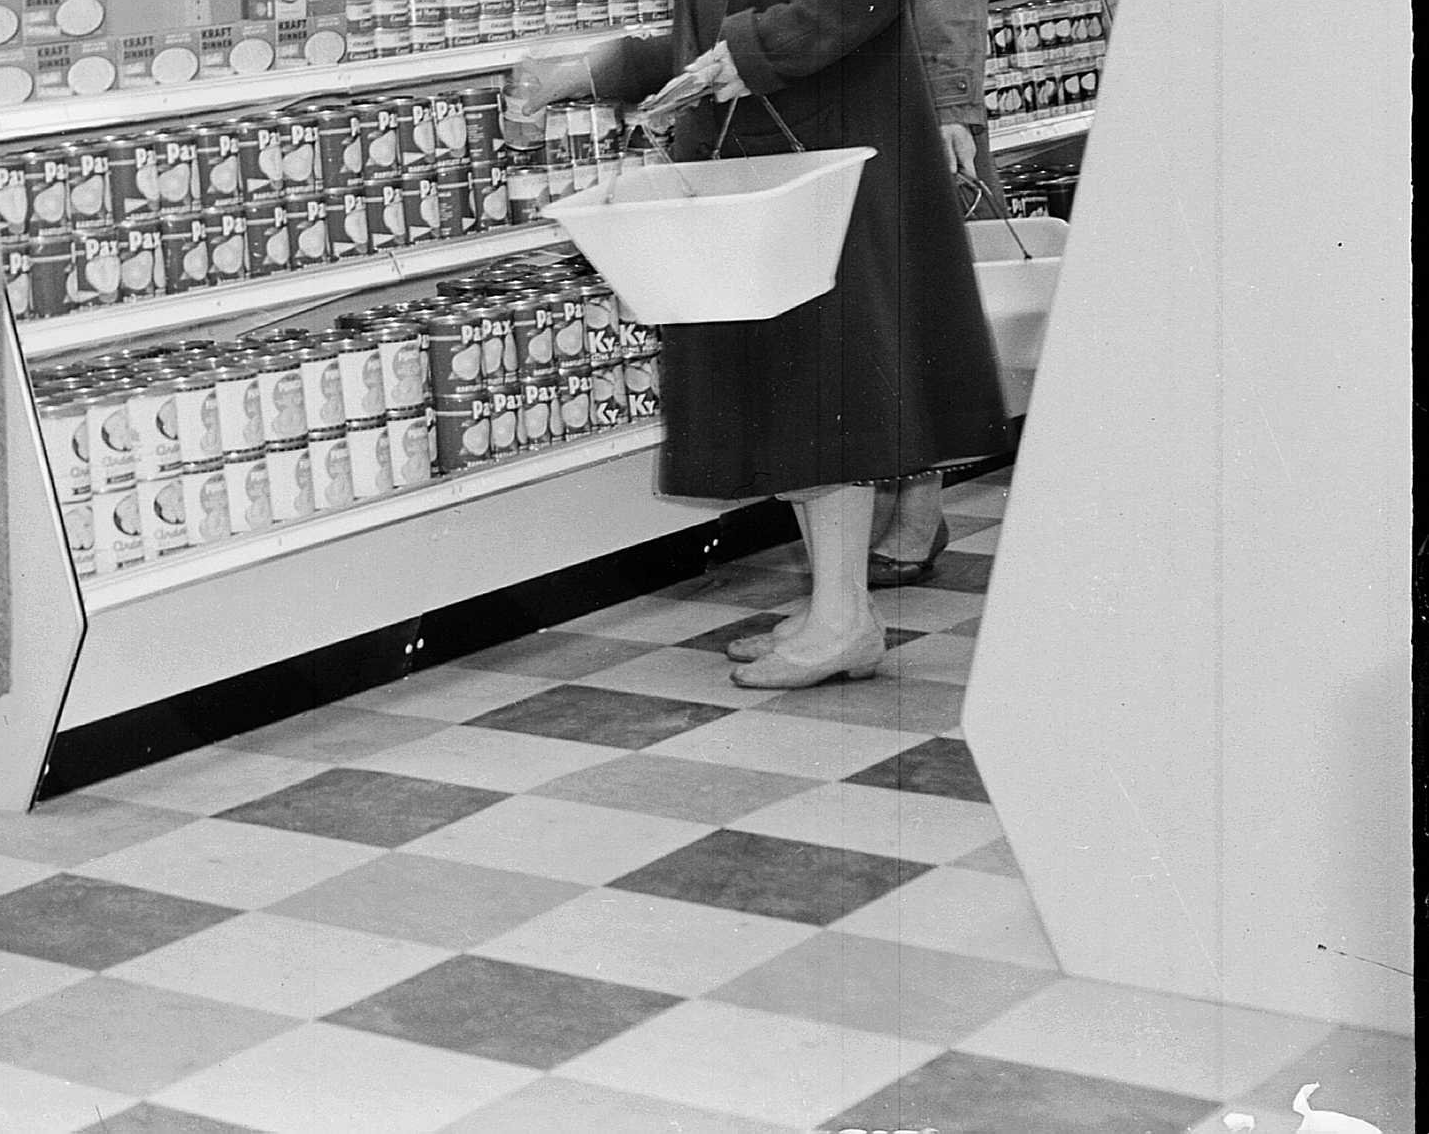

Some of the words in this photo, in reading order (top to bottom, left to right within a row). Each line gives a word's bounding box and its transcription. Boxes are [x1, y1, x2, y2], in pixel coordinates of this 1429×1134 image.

[278, 19, 308, 31] KRAFT
[201, 27, 233, 39] KRAFT
[279, 31, 309, 43] DINNER
[122, 36, 155, 48] KRAFT
[202, 39, 233, 51] DINNER
[38, 45, 70, 57] KRAFT
[123, 48, 156, 61] DINNER
[38, 58, 71, 70] DINNER
[86, 238, 118, 261] Pax
[525, 385, 557, 405] Pax
